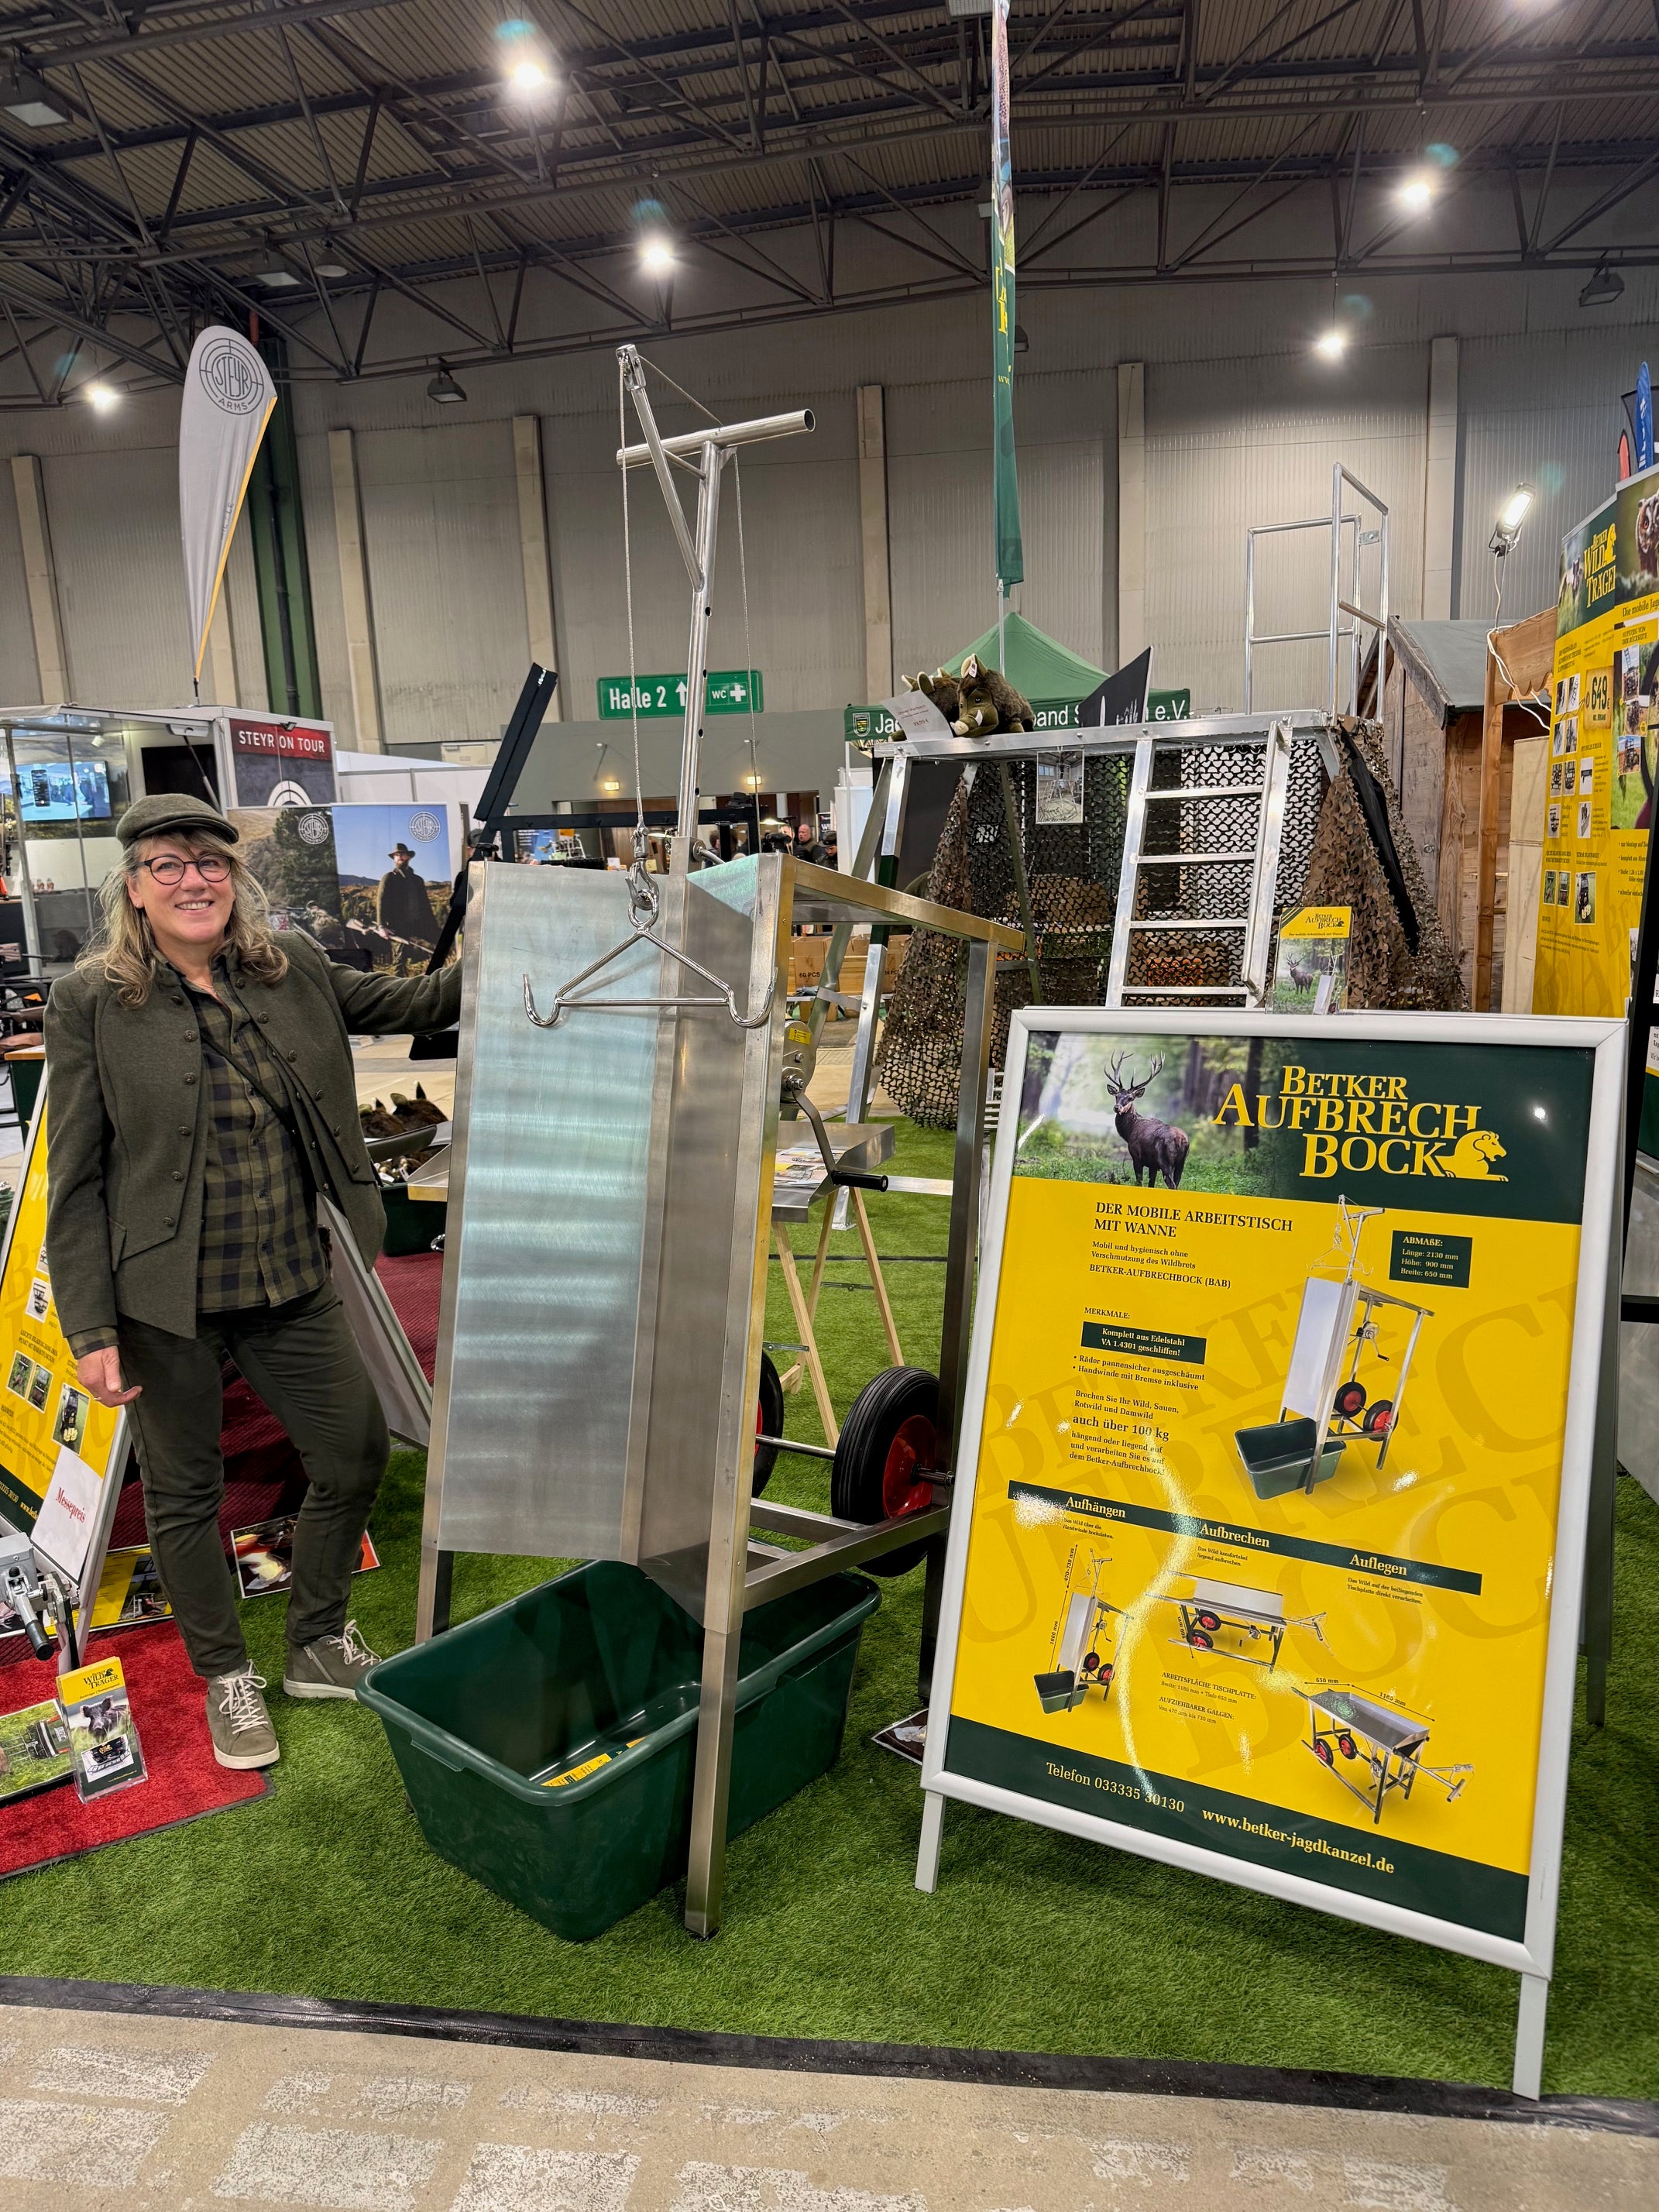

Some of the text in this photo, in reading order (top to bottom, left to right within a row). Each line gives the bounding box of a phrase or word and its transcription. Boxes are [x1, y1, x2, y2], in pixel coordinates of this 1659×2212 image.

[215, 356, 249, 397] STEYR
[218, 398, 248, 411] ARMS
[1584, 544, 1606, 579] WILD
[1623, 606, 1631, 617] Die
[1632, 600, 1649, 614] mobile
[609, 685, 726, 709] Halle 2 WC
[1155, 699, 1187, 720] e.V.
[239, 730, 325, 753] STEYR ON TOUR
[1279, 1065, 1408, 1101] BETKER
[1210, 1083, 1482, 1139] AUFBRECH
[1298, 1132, 1448, 1179] BOCK
[1094, 1218, 1176, 1238] MIT WANNE
[1095, 1202, 1293, 1231] DER MOBILE ARBEITSTISCH
[1091, 1251, 1196, 1269] Verschmutzung des Wildbrets
[1092, 1241, 1188, 1258] Mobil und hygienisch ohne
[1402, 1249, 1424, 1257] Länge:
[1401, 1258, 1422, 1266] Höhe:
[1089, 1264, 1231, 1289] BETKER-AUFBRECHBOCK (BAB)
[1084, 1307, 1130, 1319] MERKMALE:
[1101, 1338, 1180, 1356] VA 1.4301 geschliffen!
[1102, 1328, 1135, 1339] Komplett
[1151, 1335, 1185, 1346] Edelstahl
[1078, 1365, 1199, 1390] Handwinde mit Bremse inklusive
[1079, 1355, 1205, 1380] Räder pannensicher ausgeschäumt
[1074, 1400, 1153, 1420] Rotwild und Damwild
[1076, 1389, 1104, 1401] Brechen
[1119, 1396, 1131, 1405] Ihr
[1132, 1399, 1152, 1409] Wild,
[1154, 1403, 1179, 1413] Sauen,
[1073, 1416, 1170, 1442] auch über 100 kg
[1070, 1442, 1084, 1451] und
[1086, 1445, 1127, 1458] verarbeiten
[1128, 1452, 1141, 1461] Sie
[1071, 1431, 1101, 1443] hängend
[1104, 1436, 1120, 1446] oder
[1121, 1439, 1148, 1451] liegend
[1069, 1451, 1165, 1476] dem Betker-Aufbrechbock!
[56, 1487, 86, 1523] Messepreis
[1066, 1496, 1126, 1518] Aufhängen
[1200, 1524, 1270, 1548] Aufbrechen
[1349, 1554, 1407, 1576] Auflegen
[1347, 1584, 1375, 1595] Tischplatte
[1392, 1594, 1423, 1605] verarbeiten.
[83, 1674, 105, 1685] WILD
[1162, 1672, 1256, 1700] ARBEITSFLÄCHE TISCHPLATTE:
[1159, 1696, 1235, 1719] AUFZIEHBARER GALGEN:
[1046, 1762, 1395, 1874] Telefon 033335 30130 www.betker-jagdkanzel.de
